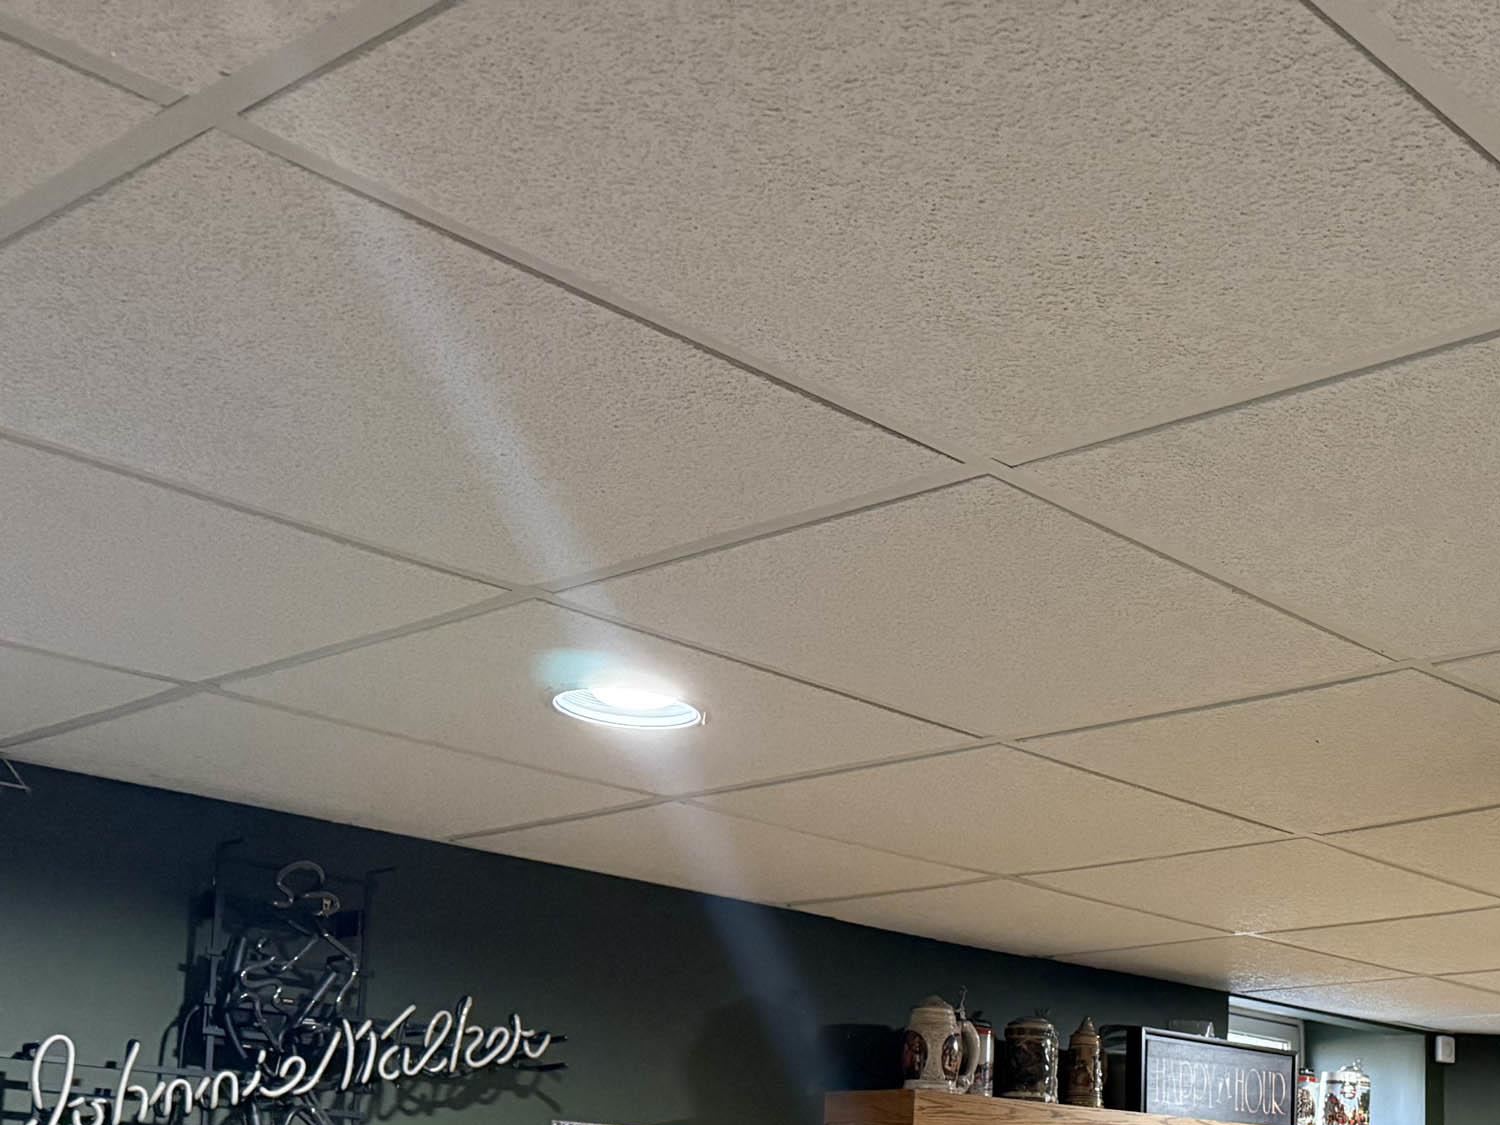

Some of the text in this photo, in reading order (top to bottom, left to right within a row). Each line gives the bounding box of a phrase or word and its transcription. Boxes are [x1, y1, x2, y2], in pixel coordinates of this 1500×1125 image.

[292, 995, 552, 1091] Walker
[1153, 1058, 1286, 1115] HAPPY HOUR
